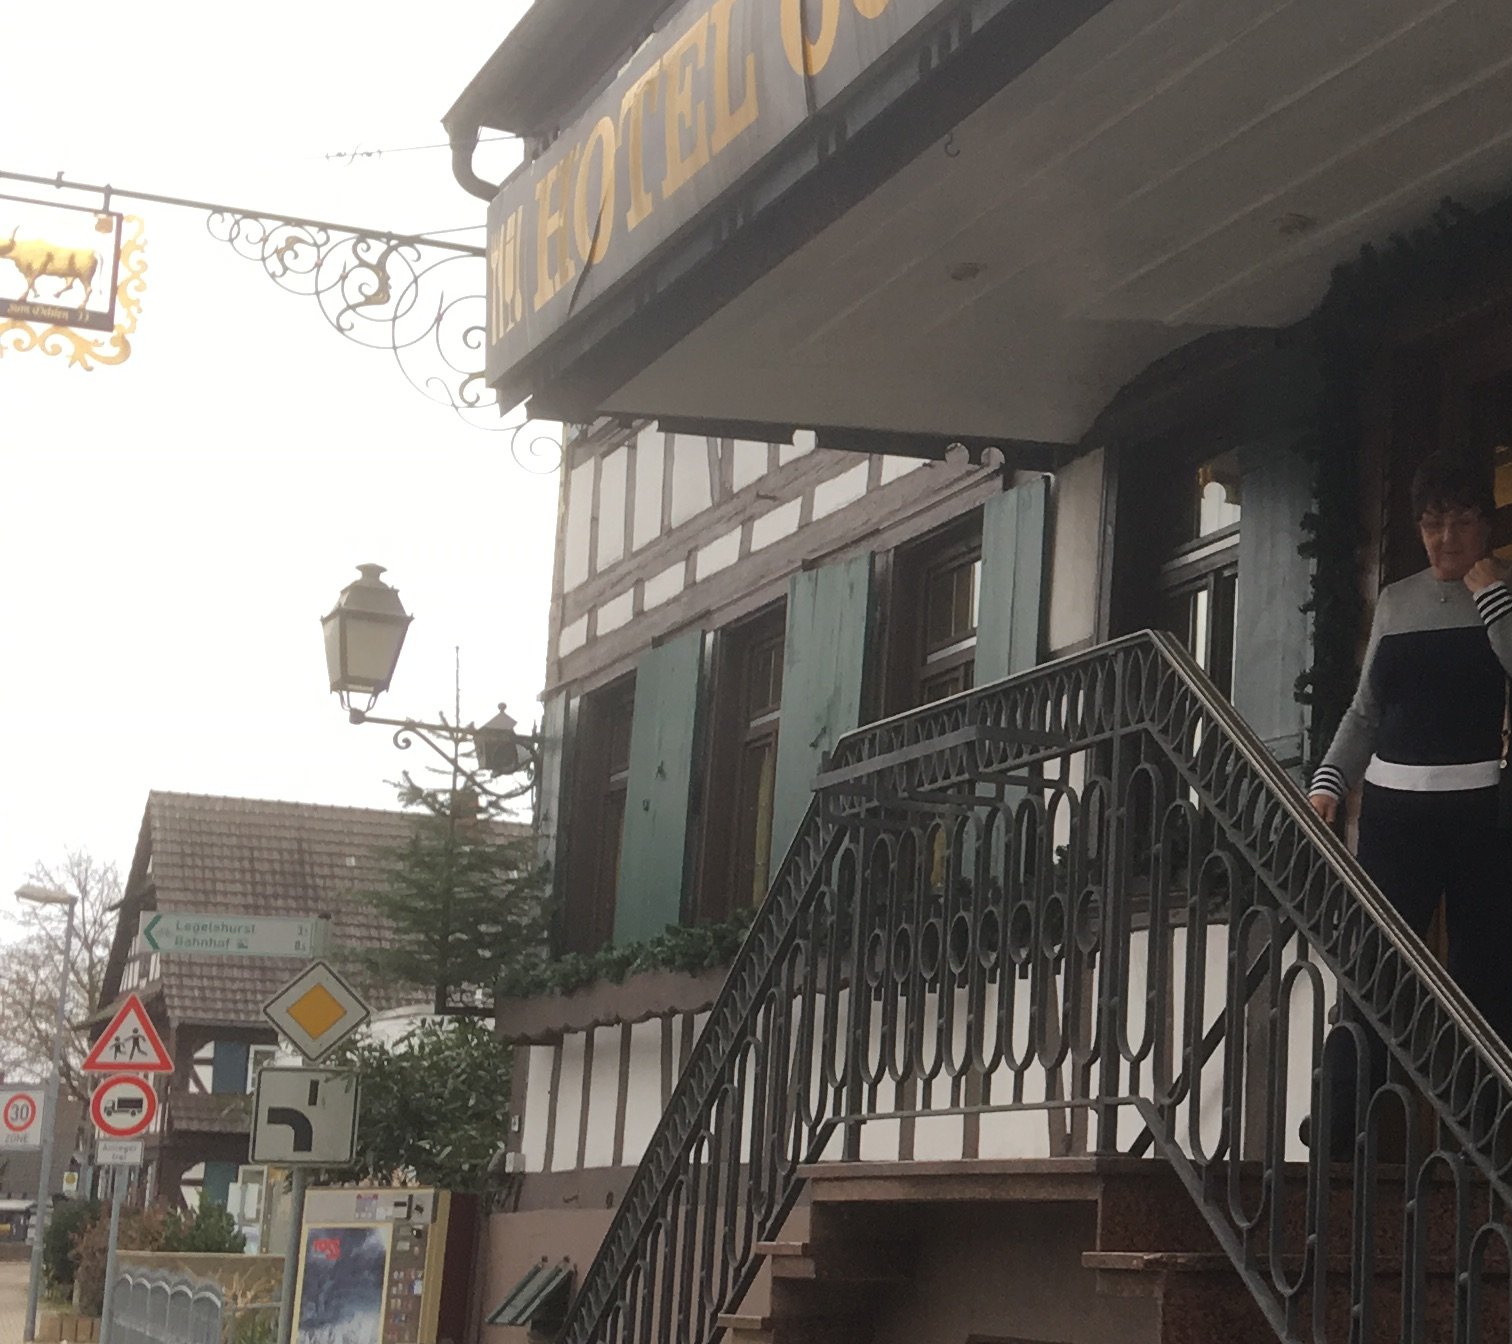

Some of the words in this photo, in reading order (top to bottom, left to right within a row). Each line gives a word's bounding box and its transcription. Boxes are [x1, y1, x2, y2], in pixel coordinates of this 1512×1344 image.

[175, 920, 256, 935] Legelshurst
[174, 935, 231, 950] Bahnhof
[10, 1103, 29, 1122] 30
